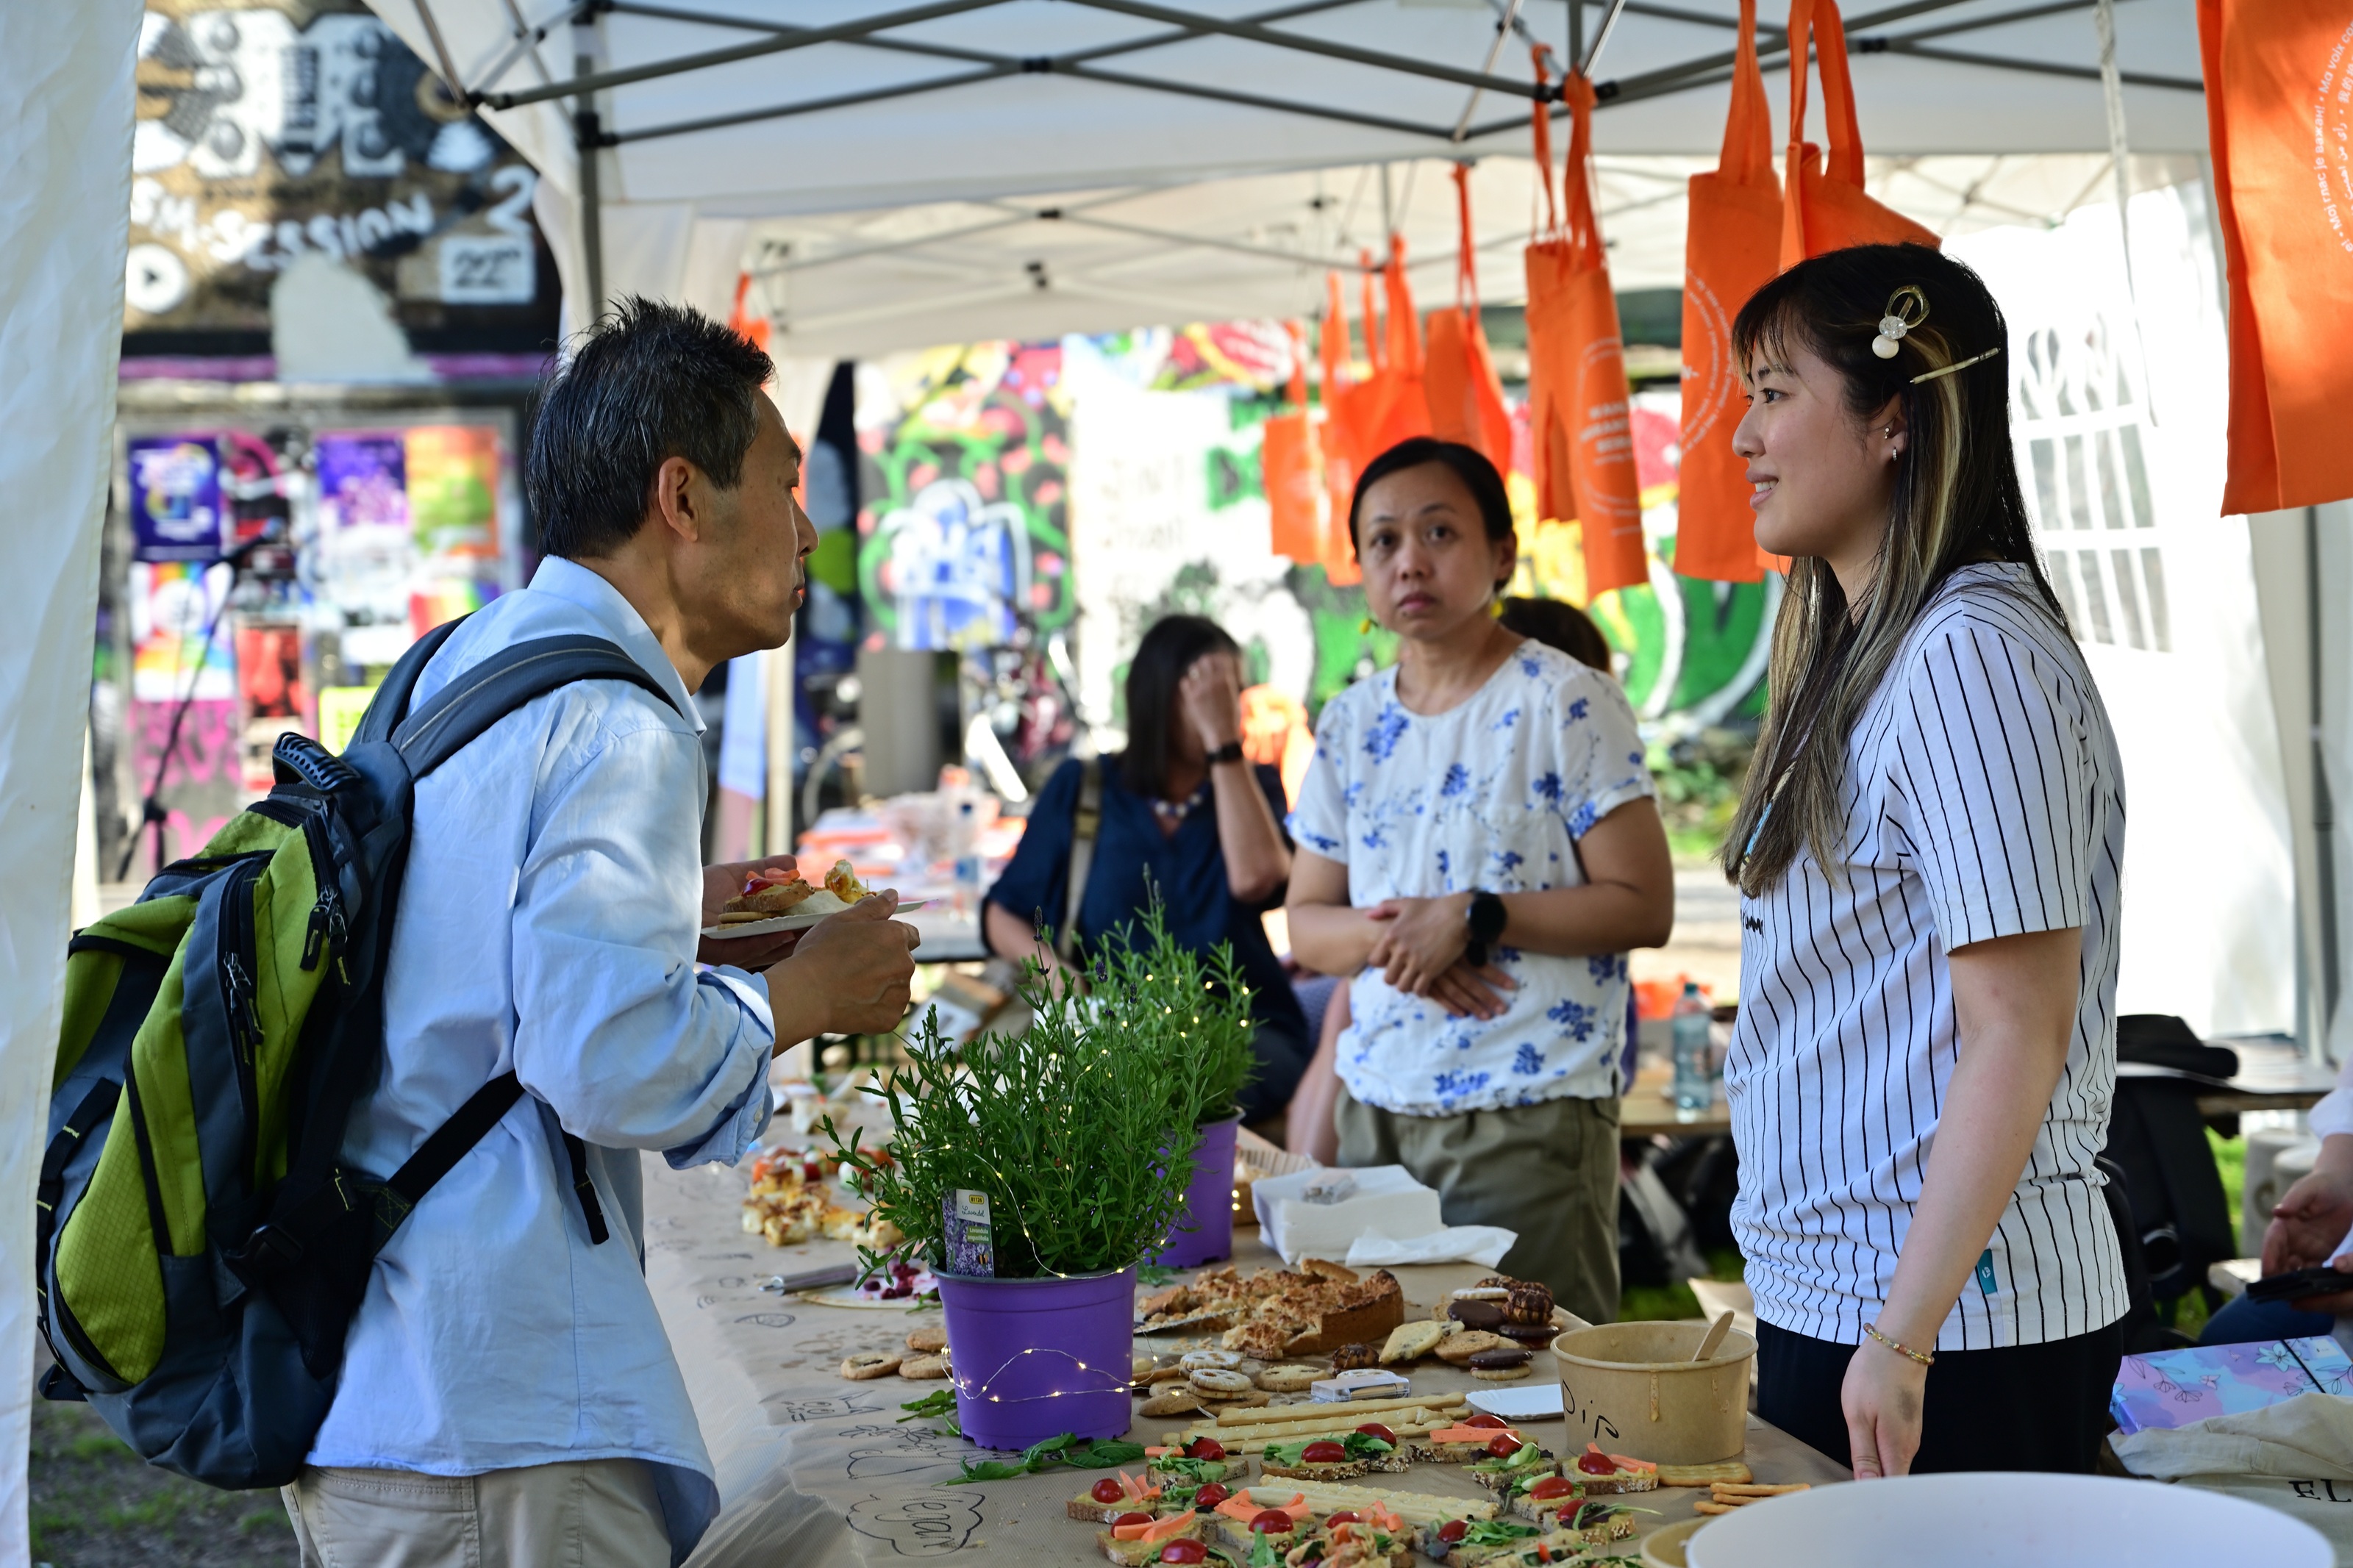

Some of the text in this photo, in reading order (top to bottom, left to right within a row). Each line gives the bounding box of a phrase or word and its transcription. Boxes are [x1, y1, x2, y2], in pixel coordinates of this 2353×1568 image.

[2318, 71, 2333, 93] Ma
[2328, 43, 2345, 69] voix
[962, 1206, 985, 1217] Lavendel
